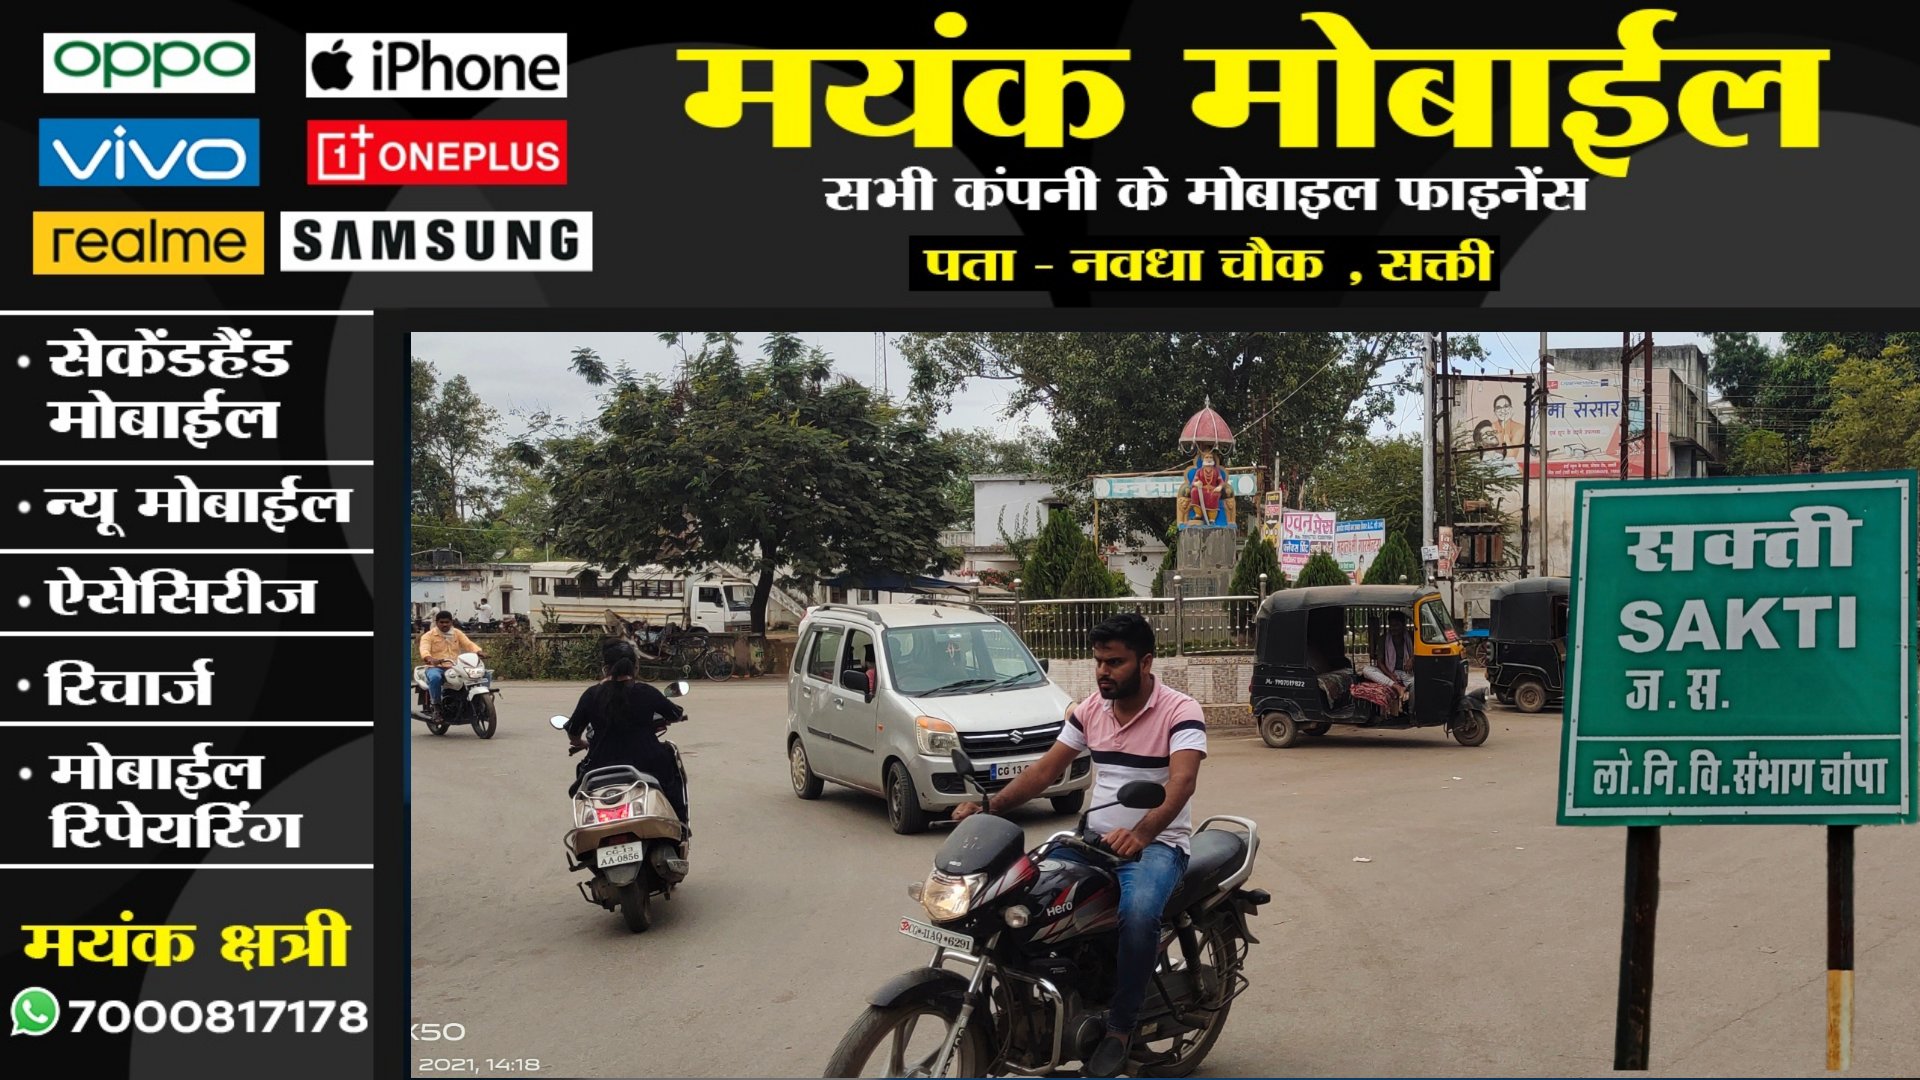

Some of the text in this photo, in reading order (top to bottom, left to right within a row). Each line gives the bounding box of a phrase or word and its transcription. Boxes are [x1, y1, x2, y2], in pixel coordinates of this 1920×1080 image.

[1573, 394, 1620, 418] संसार
[1284, 513, 1313, 538] एवन
[1625, 506, 1863, 572] सक्ती
[1618, 596, 1857, 653] SAKTI
[998, 766, 1010, 776] CG
[1013, 766, 1022, 775] 13
[1821, 751, 1889, 795] चांपा
[601, 853, 640, 865] AA-0856
[1046, 900, 1073, 917] Hero
